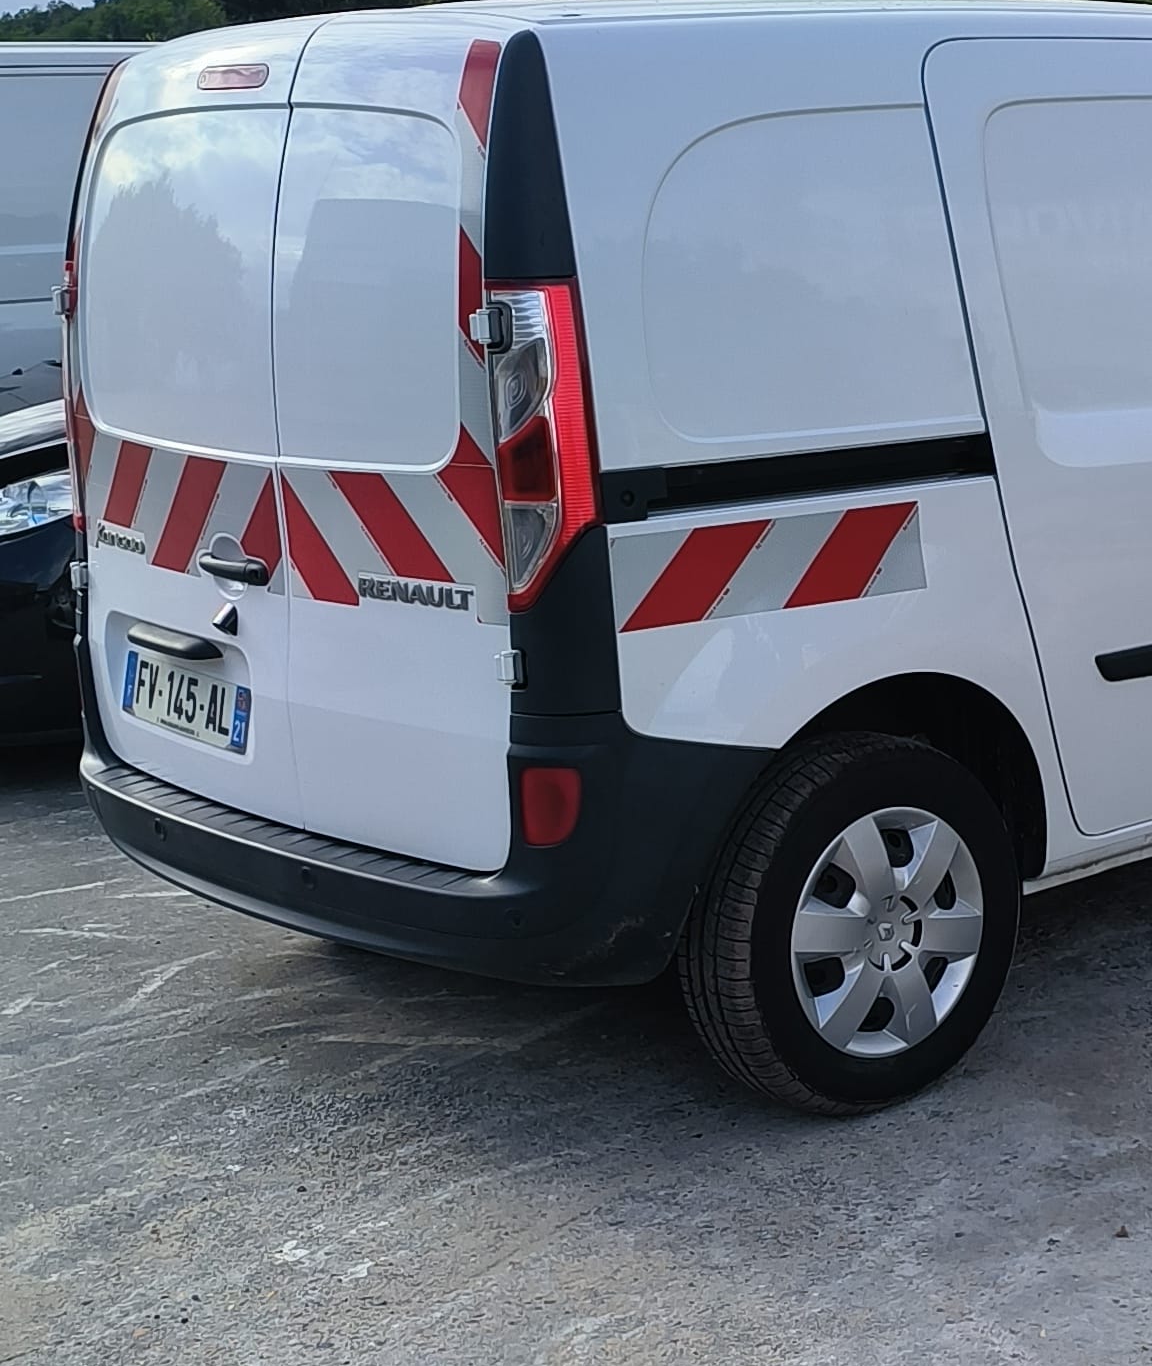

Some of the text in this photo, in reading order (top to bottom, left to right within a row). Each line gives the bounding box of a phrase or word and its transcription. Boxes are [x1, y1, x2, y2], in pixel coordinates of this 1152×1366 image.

[358, 576, 474, 611] RENAULT
[135, 659, 230, 737] FV-145-AL
[232, 720, 247, 745] 21
